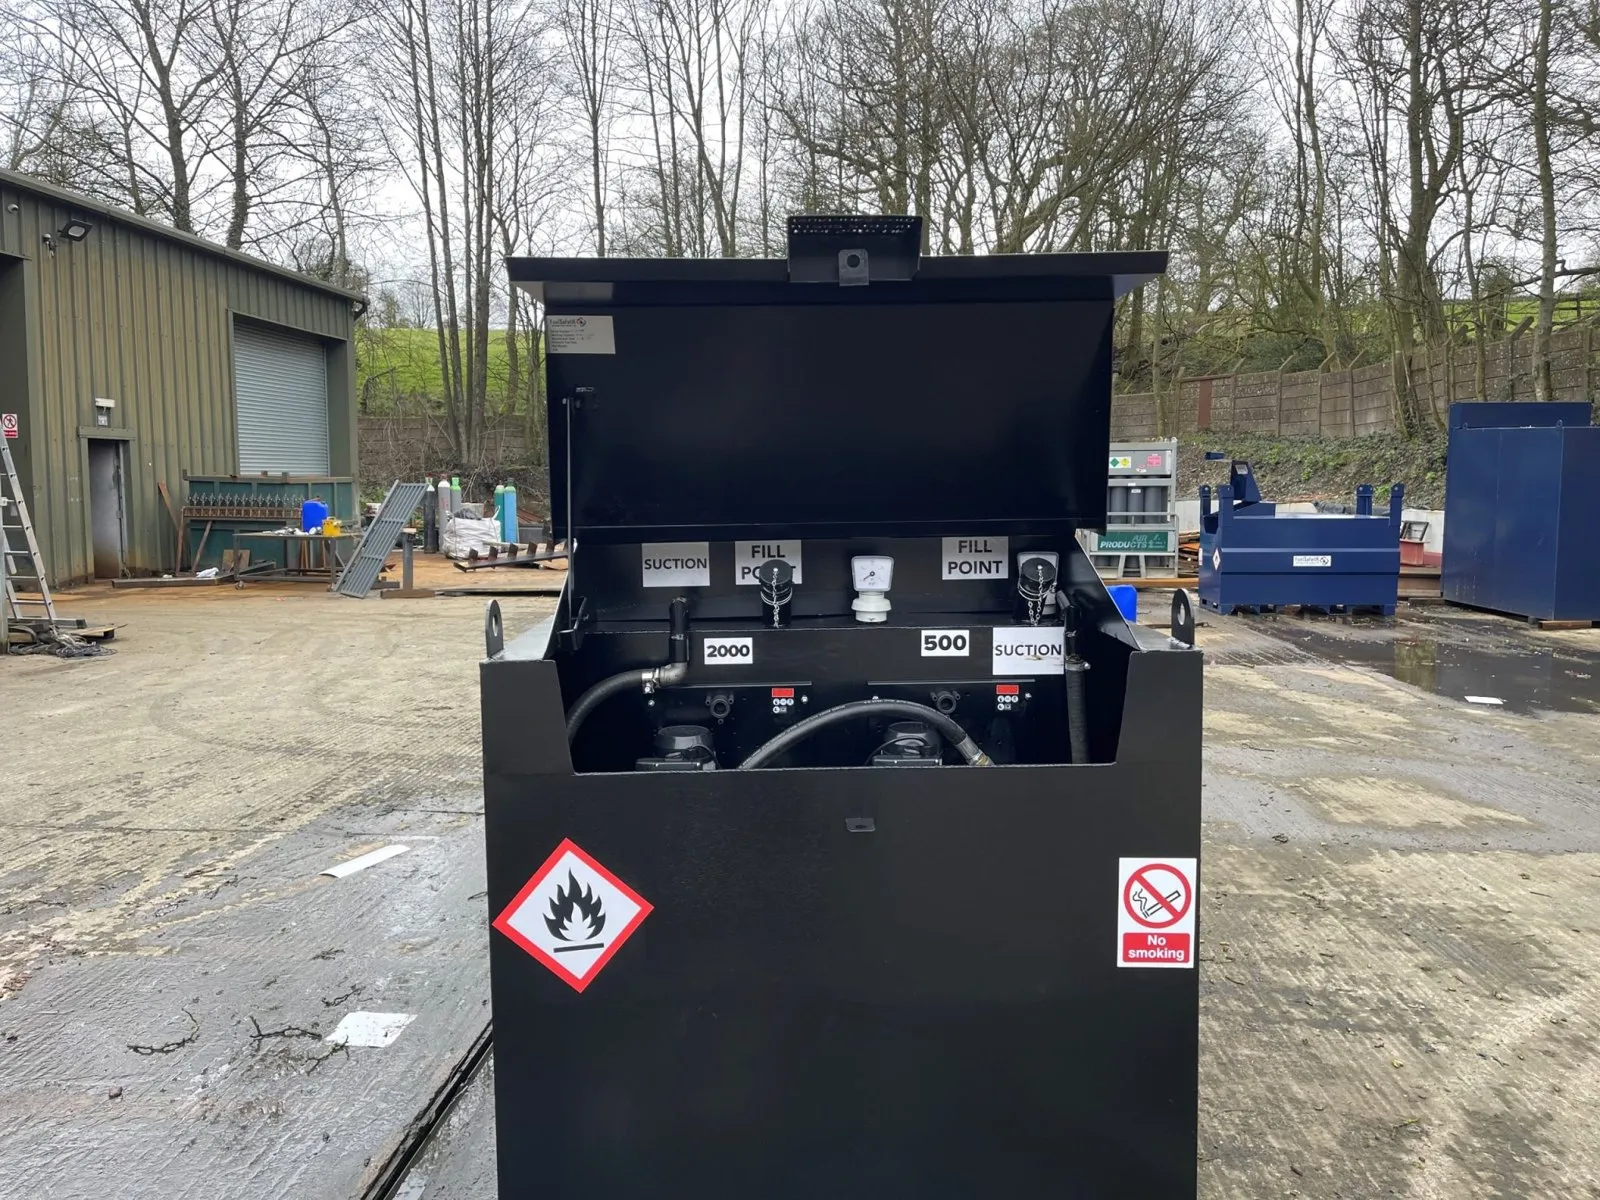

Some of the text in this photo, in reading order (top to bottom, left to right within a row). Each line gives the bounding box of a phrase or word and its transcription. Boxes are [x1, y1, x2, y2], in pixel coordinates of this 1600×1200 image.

[751, 545, 786, 558] FILL
[958, 540, 992, 553] FILL
[644, 558, 707, 569] SUCTION
[948, 560, 1003, 574] POINT
[924, 635, 967, 651] 500
[706, 644, 750, 657] 2000
[995, 644, 1062, 656] SUCTION
[1147, 934, 1166, 946] No
[1128, 947, 1185, 961] smoking
